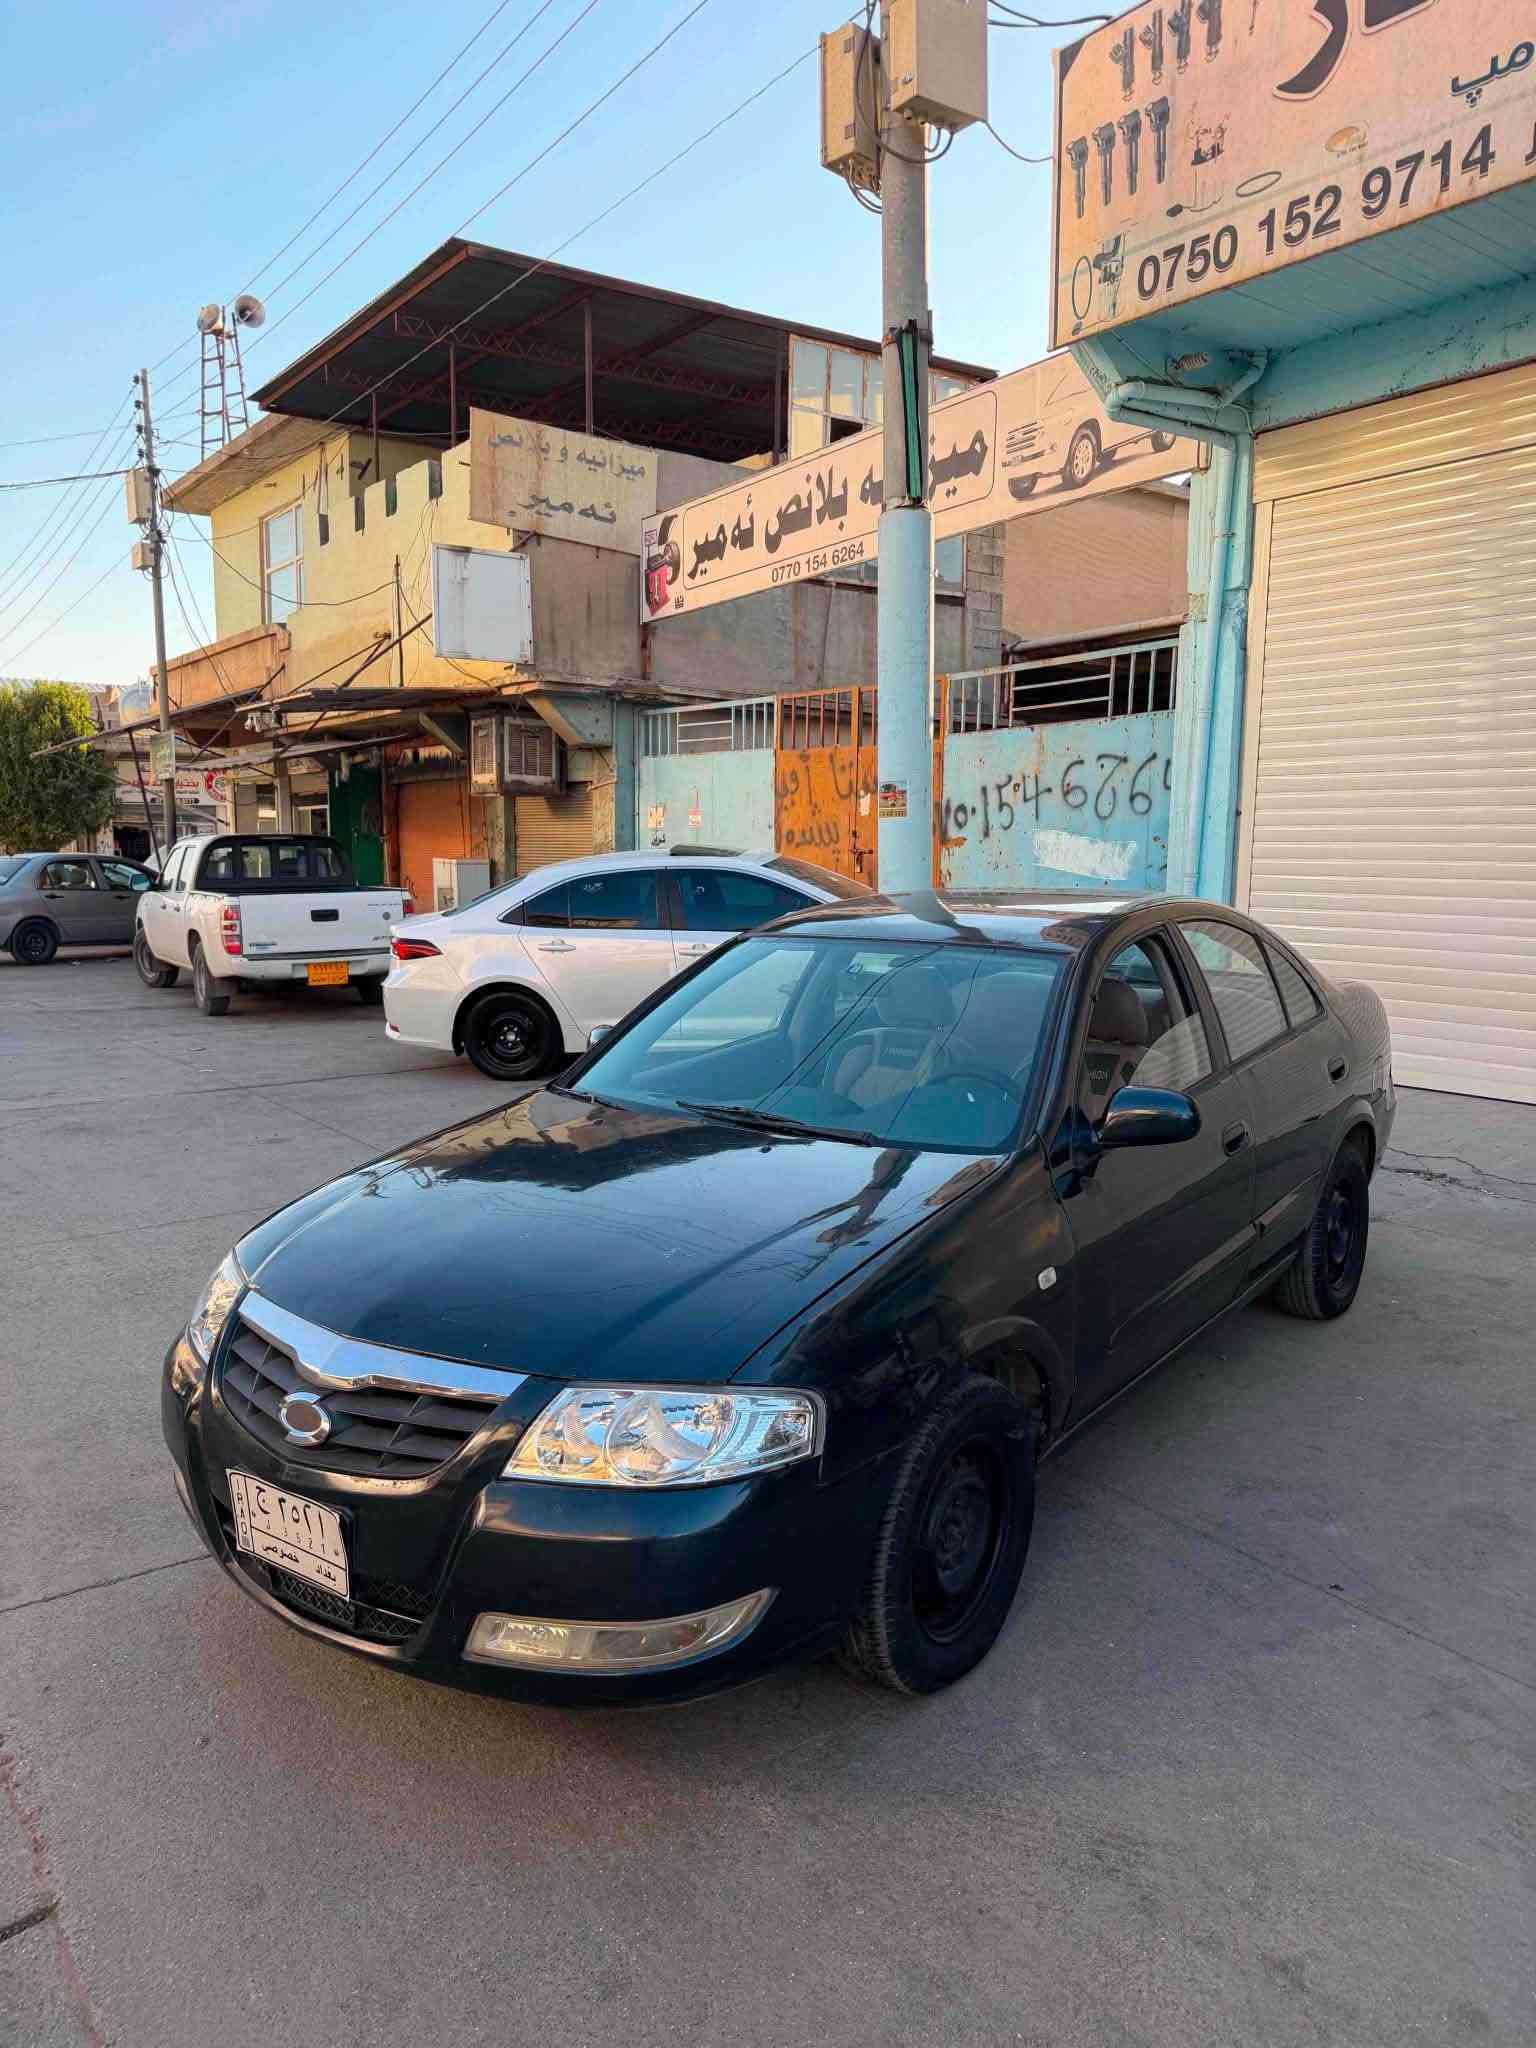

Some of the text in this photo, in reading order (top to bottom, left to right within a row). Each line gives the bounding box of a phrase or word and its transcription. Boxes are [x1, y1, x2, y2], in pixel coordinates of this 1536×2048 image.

[1137, 225, 1239, 300] 0750
[1258, 184, 1342, 256] 152
[1361, 123, 1497, 220] 9714
[771, 540, 865, 583] 0770 154 6264
[236, 1479, 248, 1535] IRAQ
